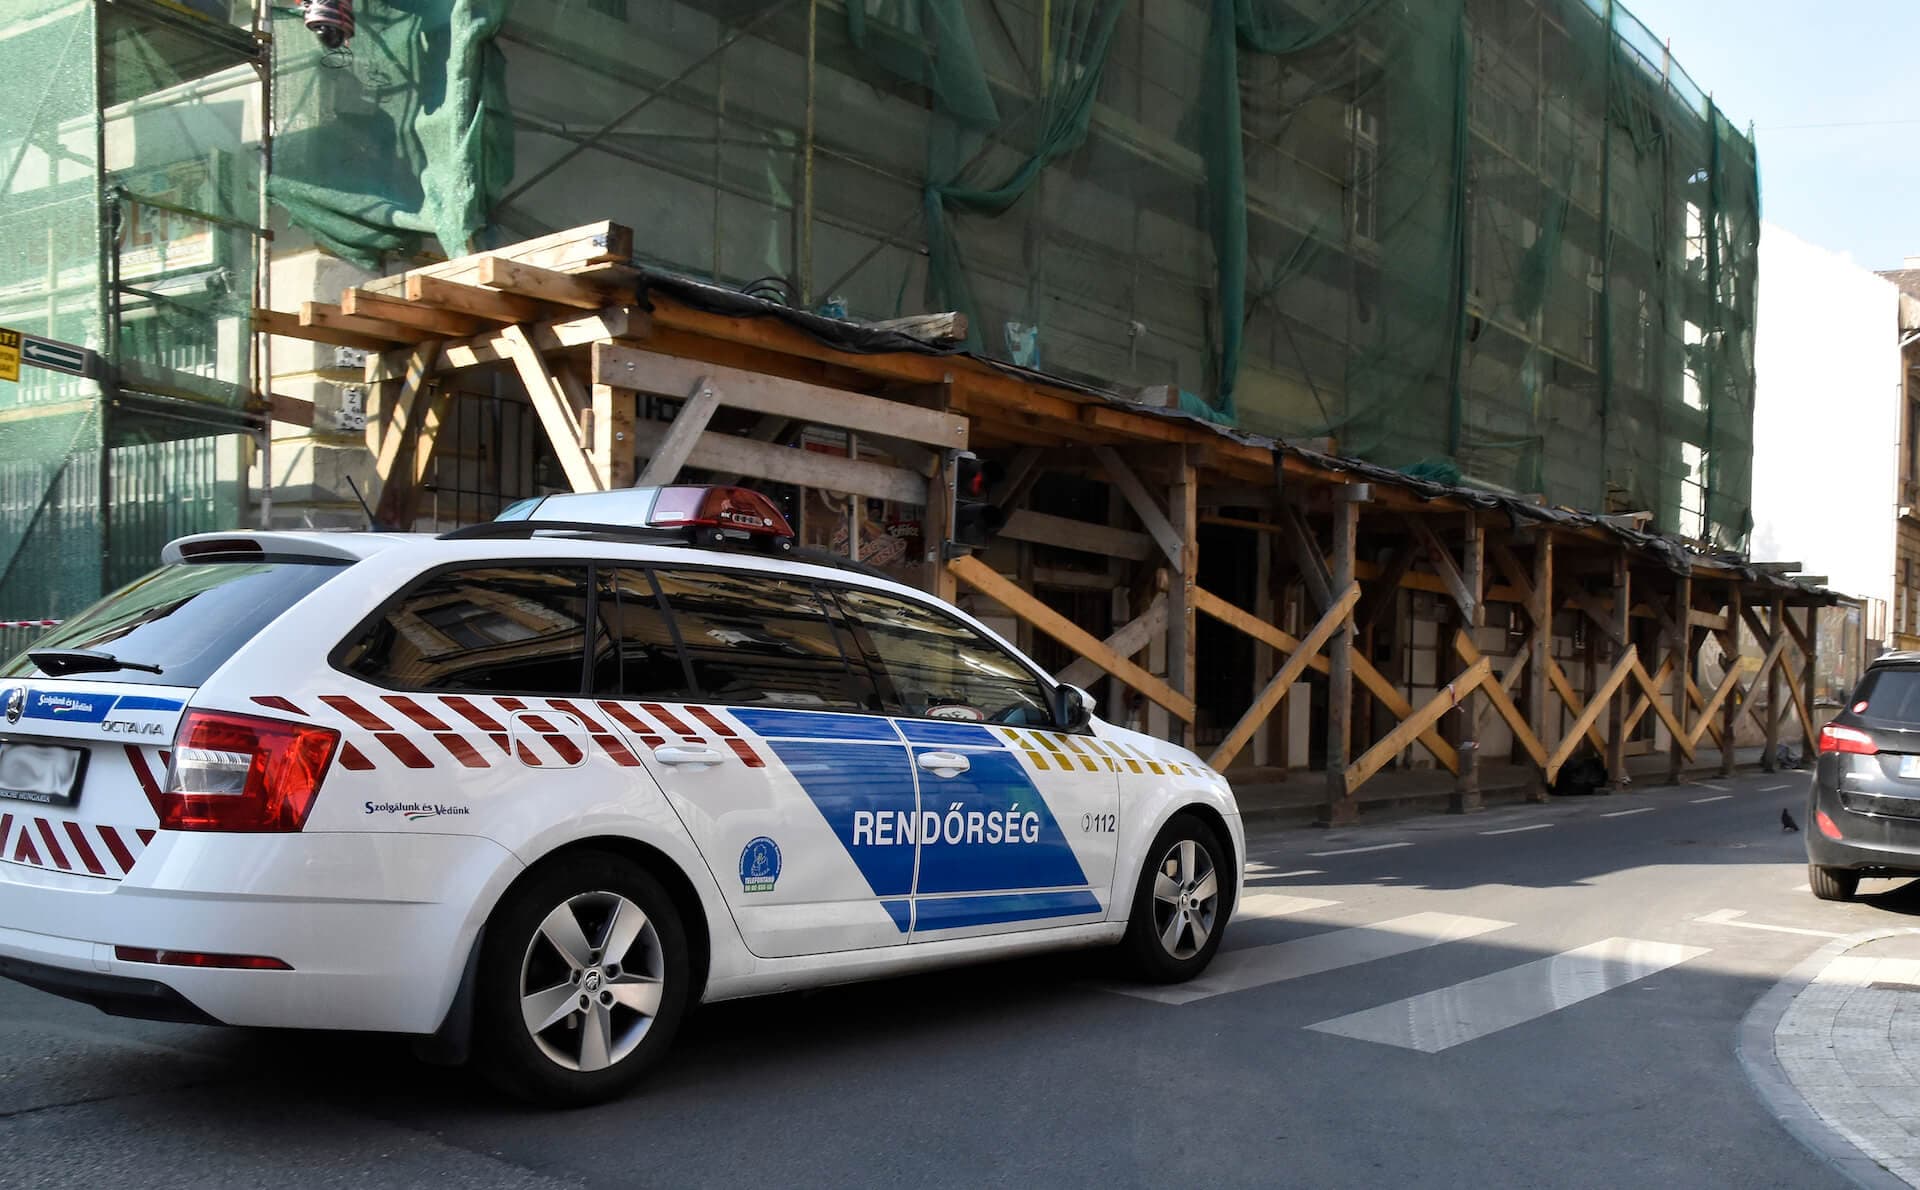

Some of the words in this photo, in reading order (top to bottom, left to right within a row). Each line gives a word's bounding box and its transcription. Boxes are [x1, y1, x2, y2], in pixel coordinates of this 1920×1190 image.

[101, 720, 165, 735] OCTAVIA
[365, 801, 420, 814] Szolgálunk
[422, 803, 433, 811] és
[434, 804, 470, 815] Védünk
[852, 802, 1041, 846] RENDŐRSÉG
[1094, 813, 1116, 833] 112
